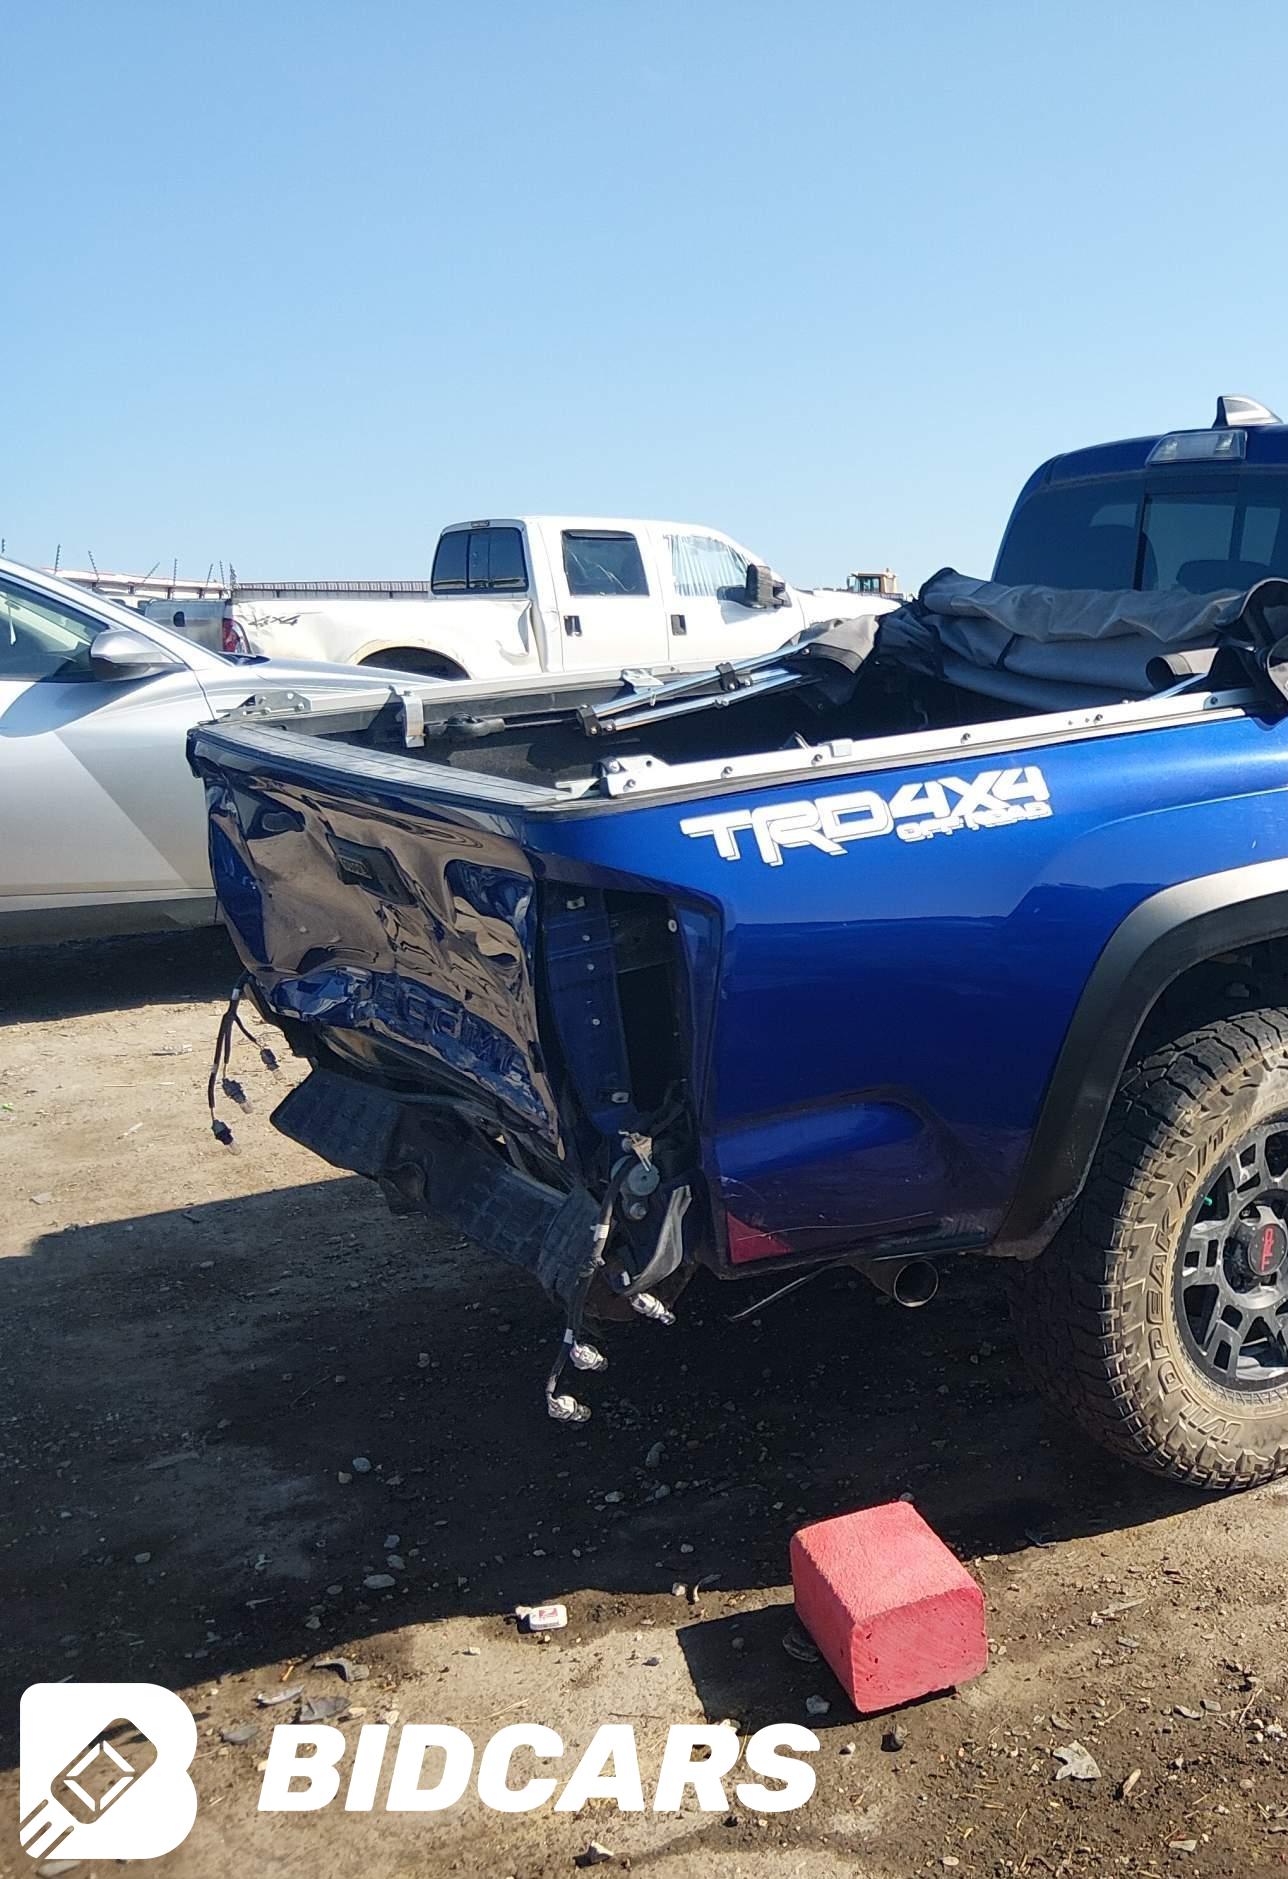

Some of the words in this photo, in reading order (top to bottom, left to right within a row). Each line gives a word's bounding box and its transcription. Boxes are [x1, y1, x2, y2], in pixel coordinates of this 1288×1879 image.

[679, 790, 894, 867] TRD
[1261, 1228, 1275, 1272] TRD
[1146, 1206, 1242, 1445] WILDPEAK
